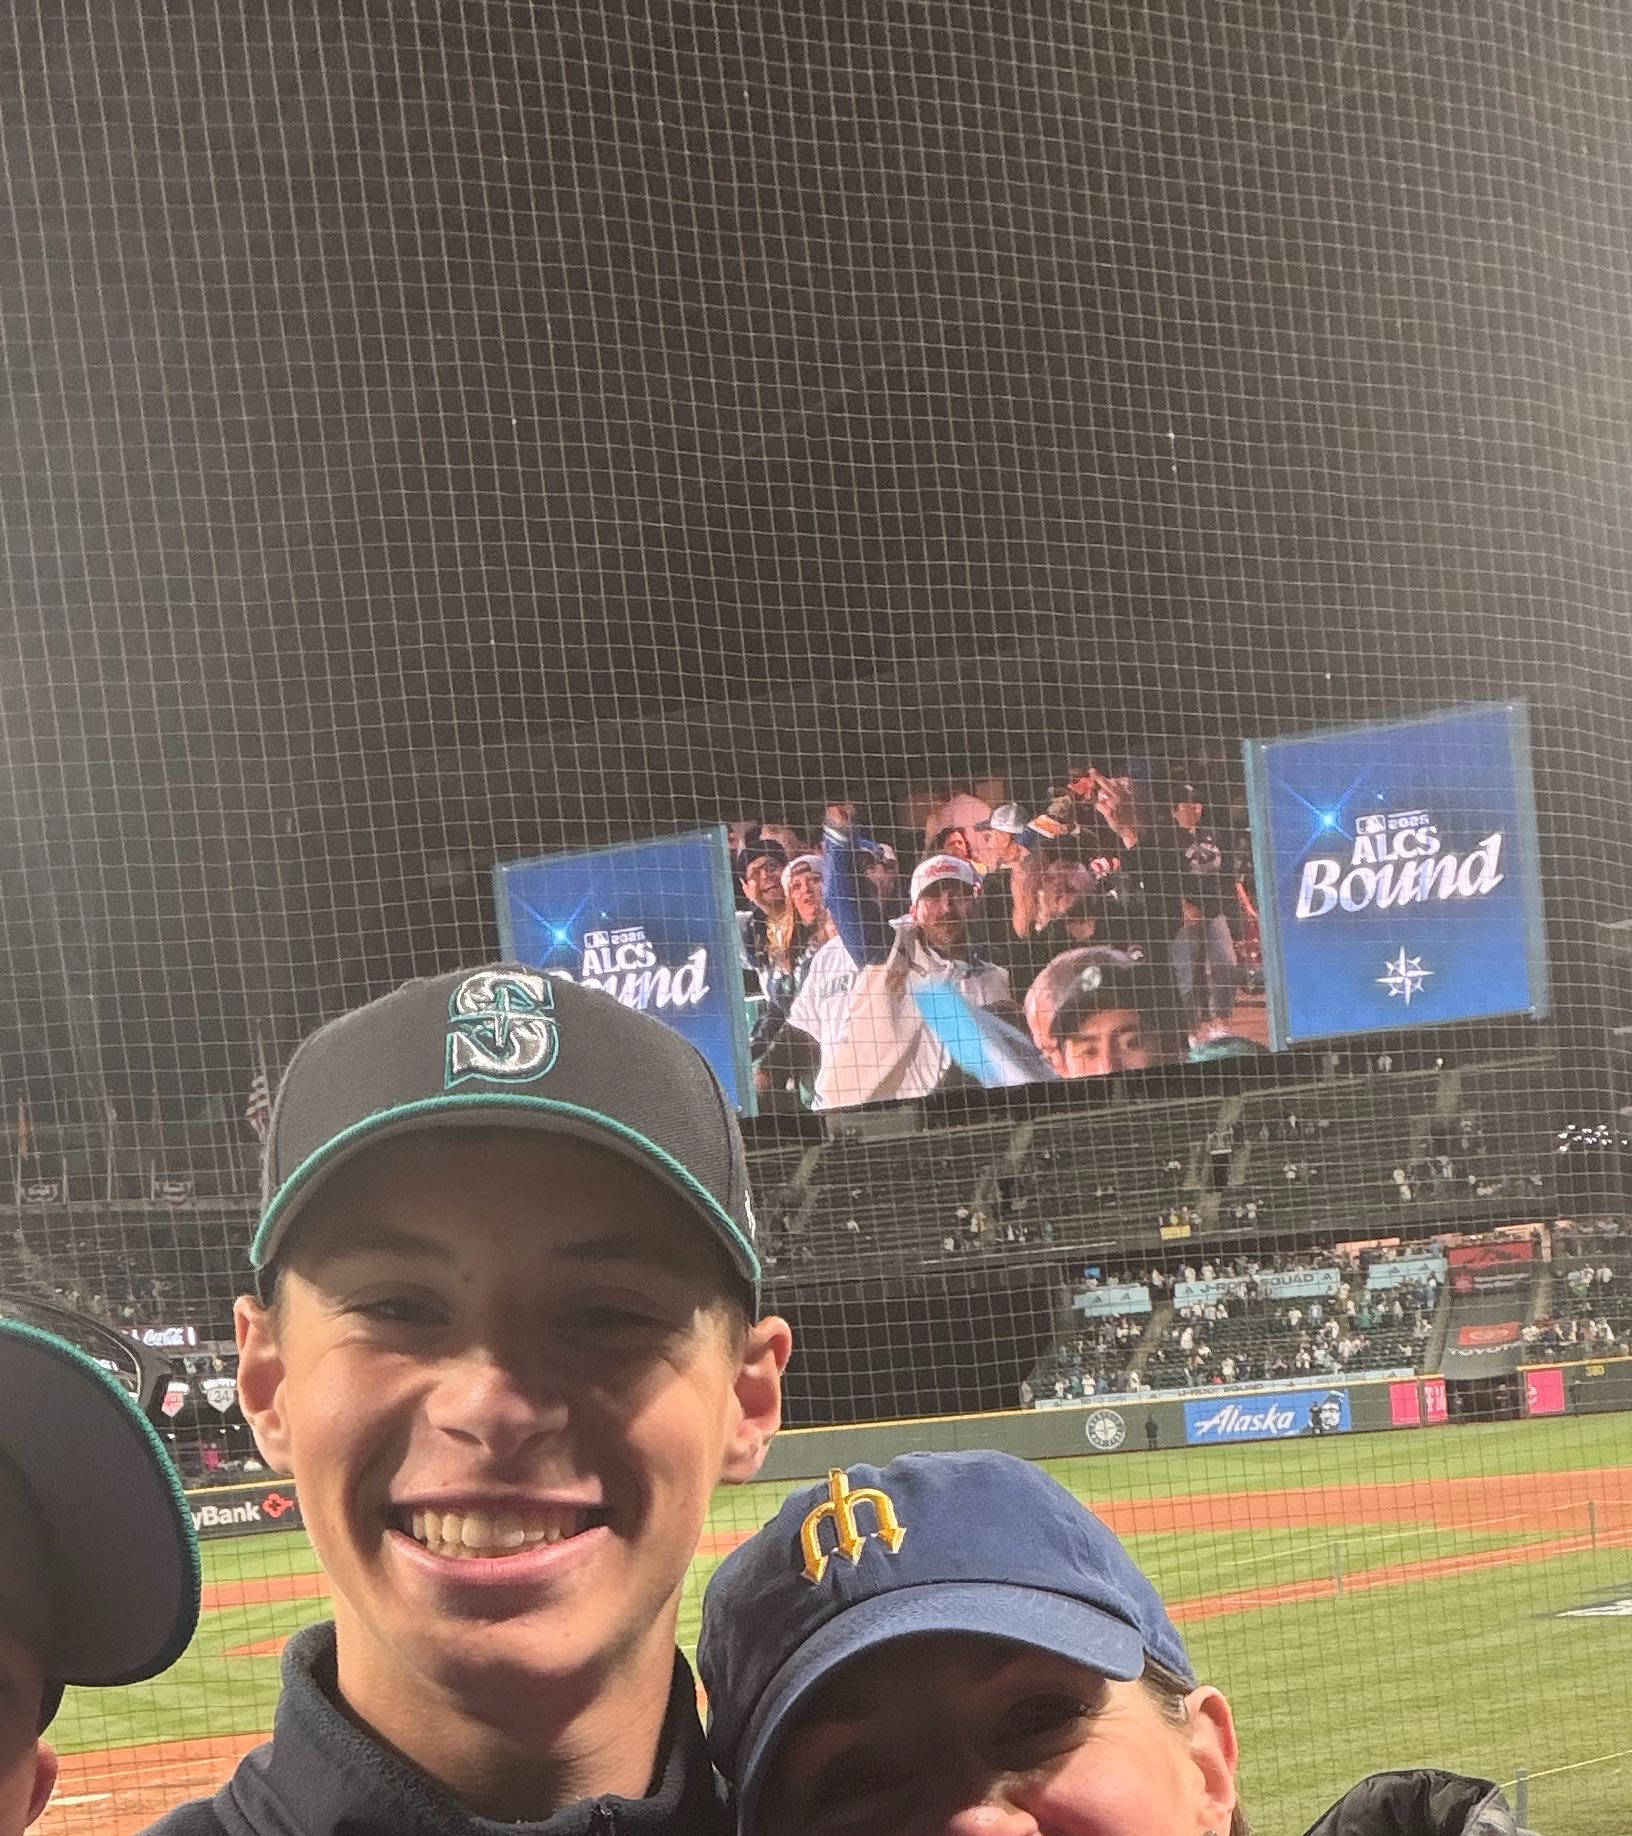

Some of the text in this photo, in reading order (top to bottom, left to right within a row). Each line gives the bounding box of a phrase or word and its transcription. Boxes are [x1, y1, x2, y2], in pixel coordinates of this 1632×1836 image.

[1350, 825, 1441, 866] ALCS
[1295, 832, 1505, 920] Bound
[582, 941, 657, 977] ALCS
[1194, 1403, 1296, 1438] Alaska
